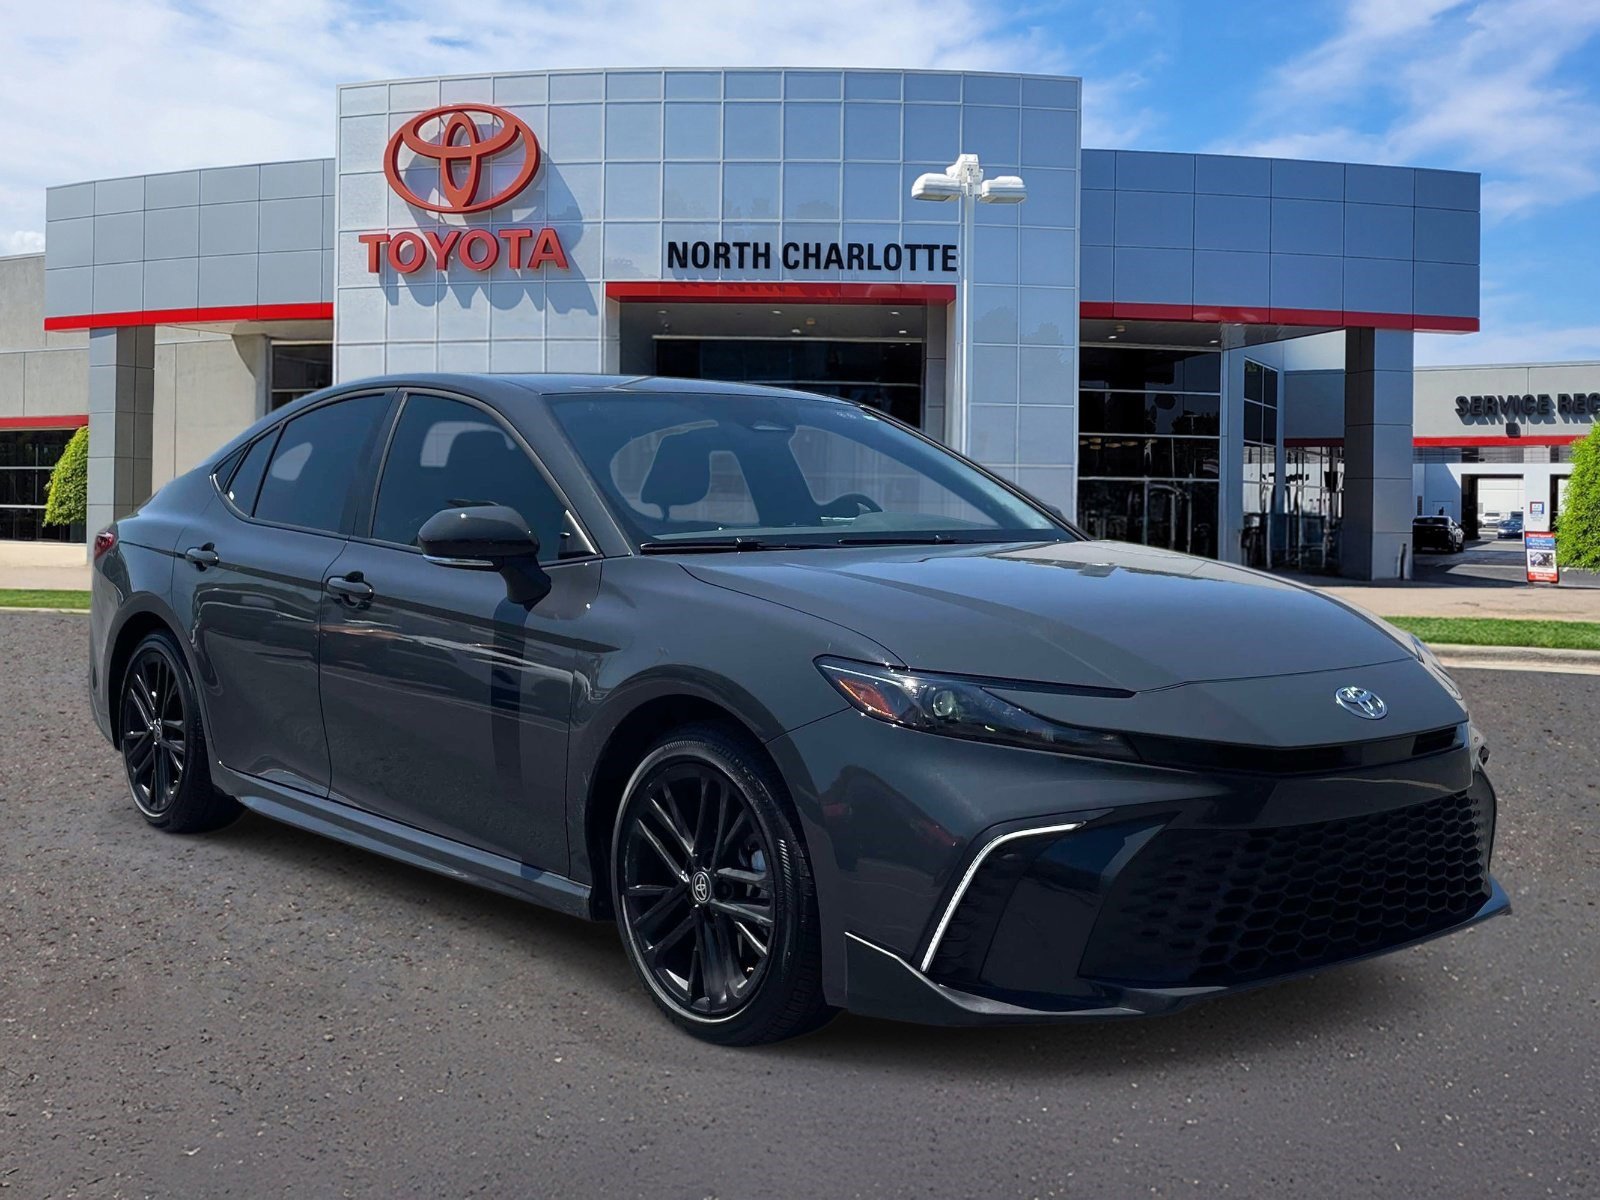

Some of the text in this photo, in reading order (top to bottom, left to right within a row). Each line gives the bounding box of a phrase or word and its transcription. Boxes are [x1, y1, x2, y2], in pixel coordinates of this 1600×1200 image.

[359, 228, 569, 273] TOYOTA
[667, 241, 957, 271] NORTH CHARLOTTE
[1455, 394, 1552, 417] SERVICE
